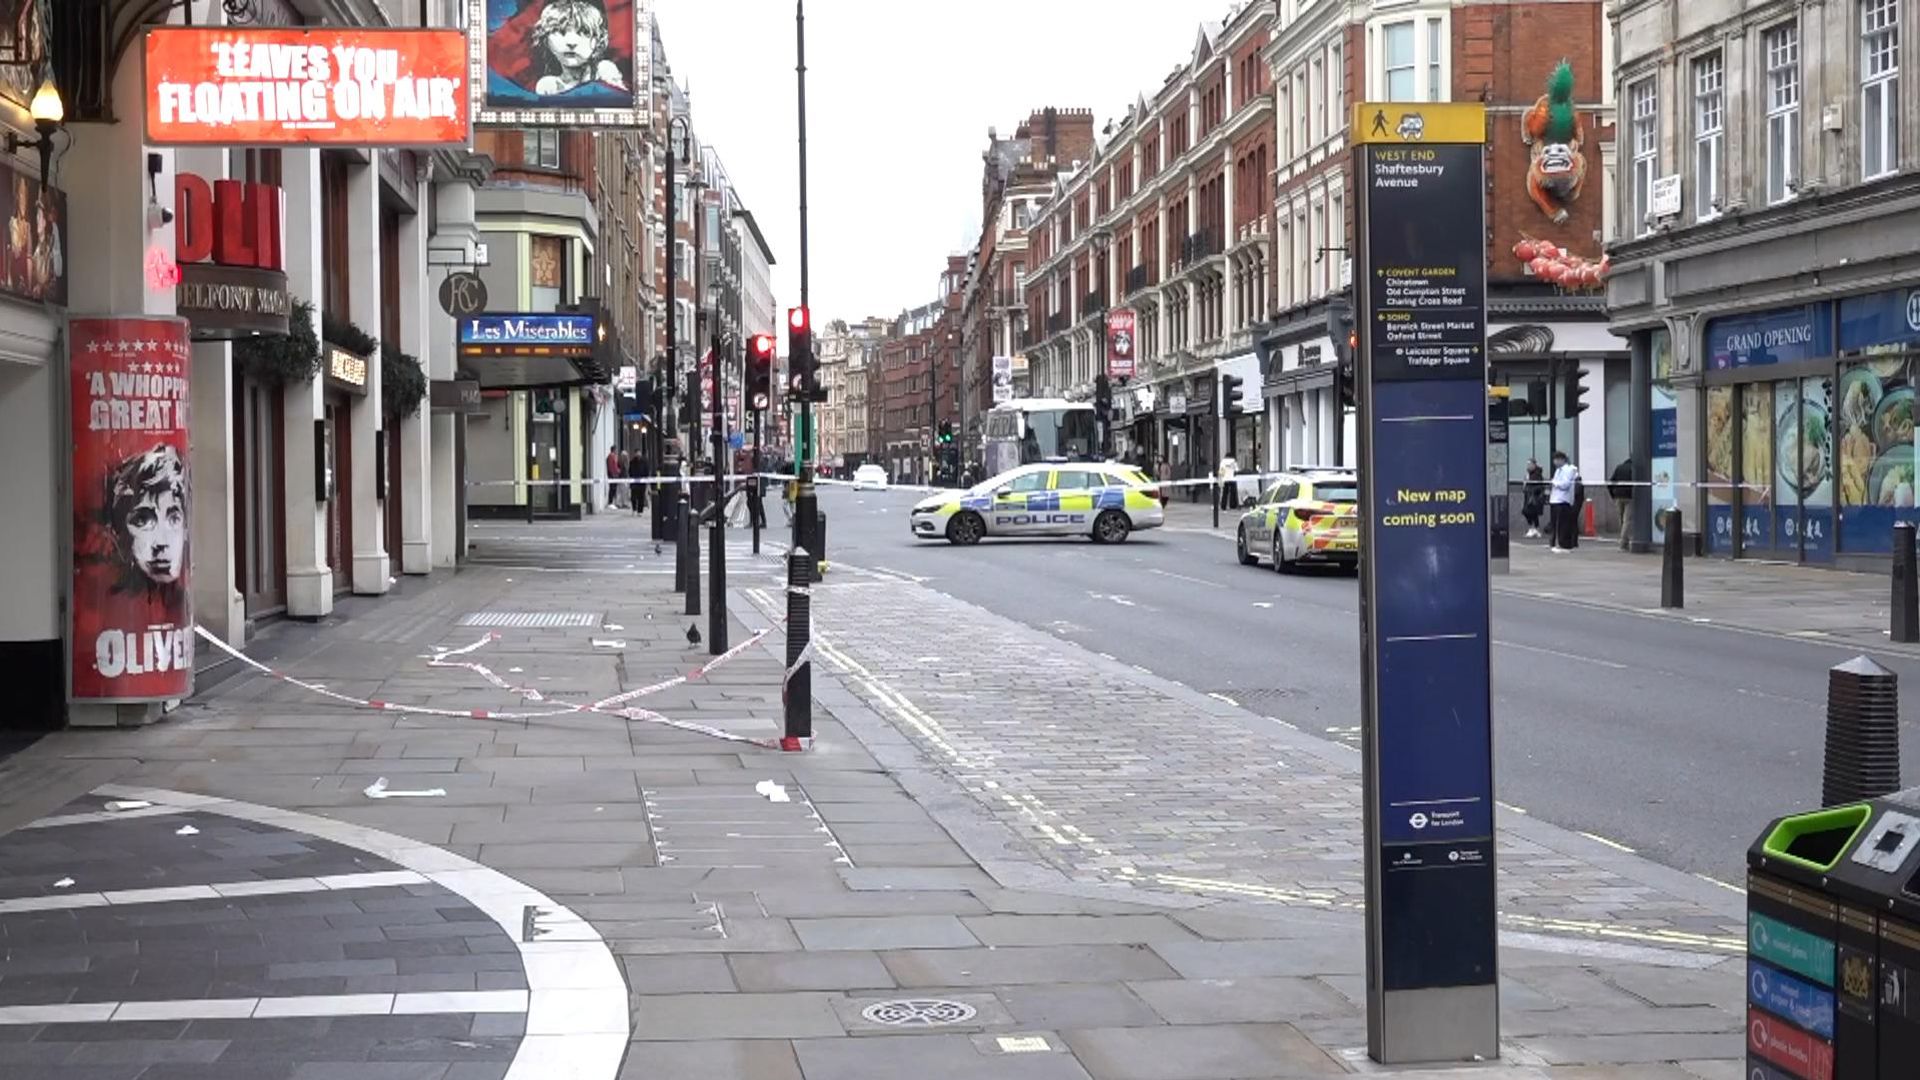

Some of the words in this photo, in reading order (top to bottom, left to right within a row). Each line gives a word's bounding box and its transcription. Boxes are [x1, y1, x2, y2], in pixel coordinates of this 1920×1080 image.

[211, 41, 331, 81] 'LEAVES
[331, 46, 398, 84] YOU
[158, 80, 327, 124] FLOATING
[333, 77, 388, 120] ON
[1375, 150, 1407, 161] WEST
[1411, 149, 1435, 160] END
[1375, 163, 1444, 178] Shaftesbury
[1375, 177, 1418, 187] Avenue
[1386, 268, 1419, 277] COVENT
[1421, 267, 1456, 276] GARDEN
[1386, 278, 1429, 286] Chinatown
[1386, 287, 1401, 296] Old
[1403, 288, 1440, 297] Compton
[1442, 286, 1466, 295] Street
[1386, 298, 1417, 307] Charing
[1418, 296, 1441, 305] Cross
[1442, 296, 1463, 305] Road
[1386, 313, 1411, 321] SOHO
[471, 319, 501, 340] Les
[1386, 322, 1418, 331] Berwick
[1420, 322, 1445, 330] Street
[1446, 321, 1475, 330] Market
[1386, 332, 1416, 341] Oxford
[1417, 332, 1442, 340] Street
[1726, 332, 1761, 351] GRAND
[1764, 324, 1811, 348] OPENING
[1405, 347, 1442, 356] Leicester
[1443, 346, 1470, 356] Square
[1407, 356, 1441, 366] Trafalgar
[1443, 356, 1470, 366] Square
[88, 398, 172, 431] GREAT
[1397, 489, 1431, 503] New
[1434, 490, 1466, 504] map
[996, 514, 1085, 525] POLICE
[1383, 512, 1436, 528] coming
[1440, 511, 1475, 524] soon
